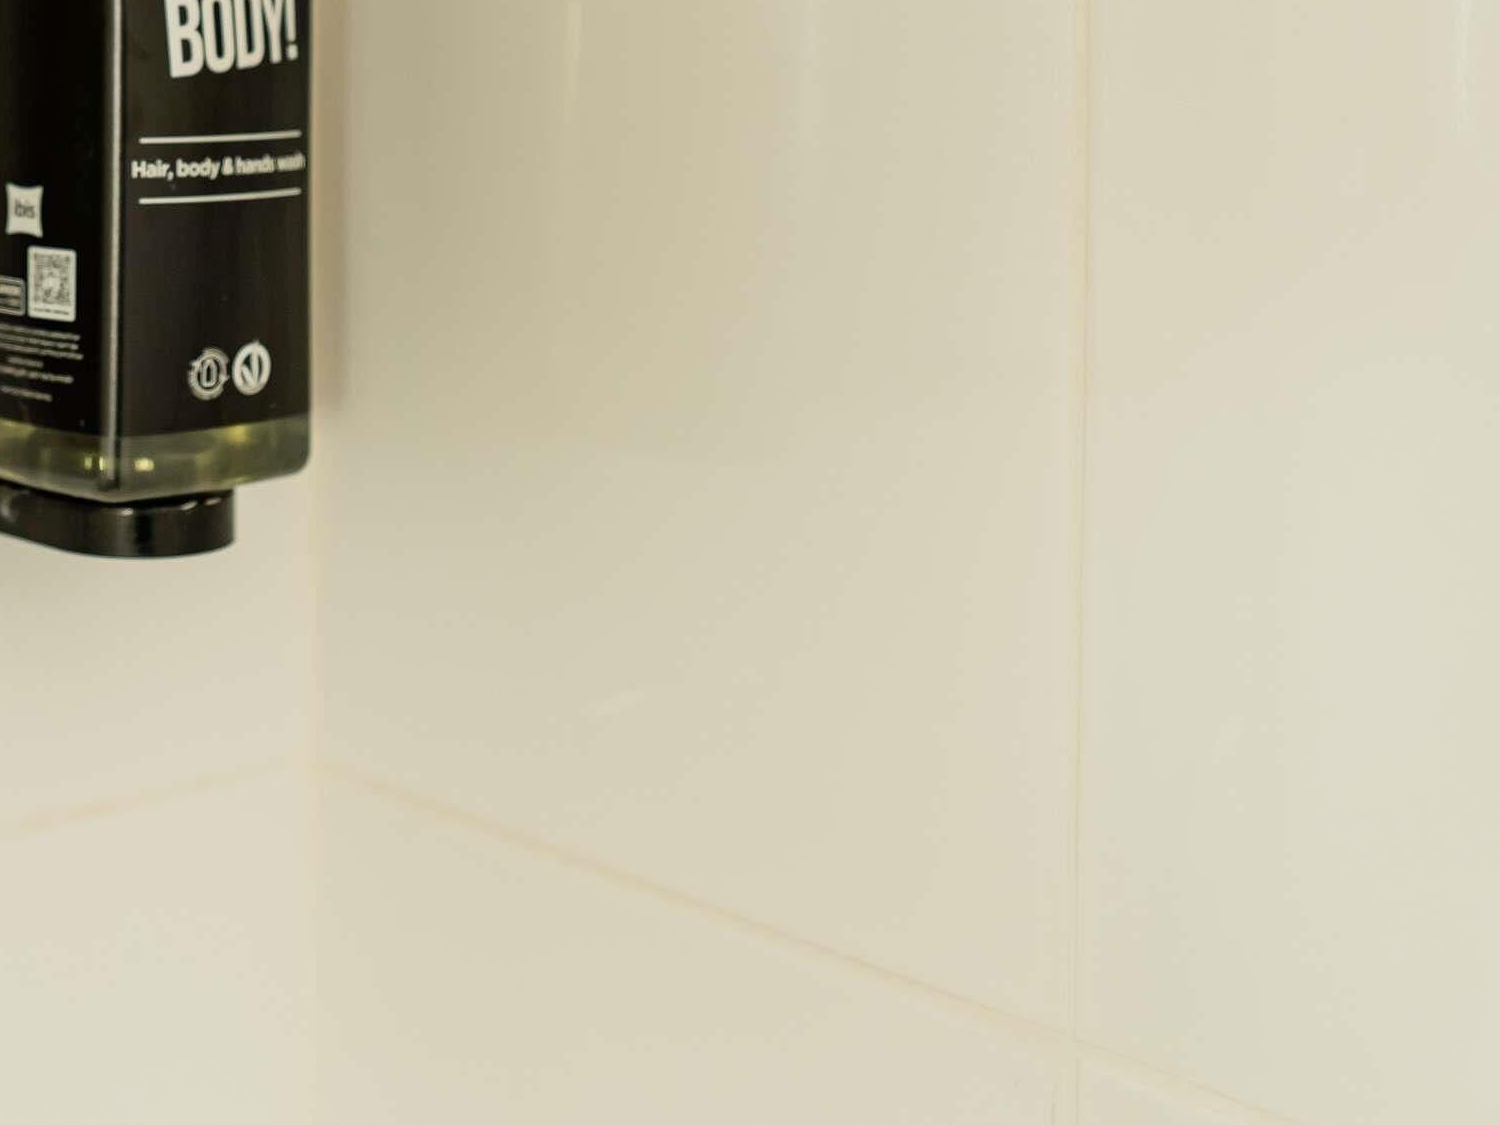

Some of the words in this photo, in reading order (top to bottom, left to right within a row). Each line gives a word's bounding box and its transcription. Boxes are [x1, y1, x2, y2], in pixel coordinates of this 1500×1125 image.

[131, 158, 174, 182] Hair,
[176, 157, 220, 181] body
[222, 156, 234, 175] &
